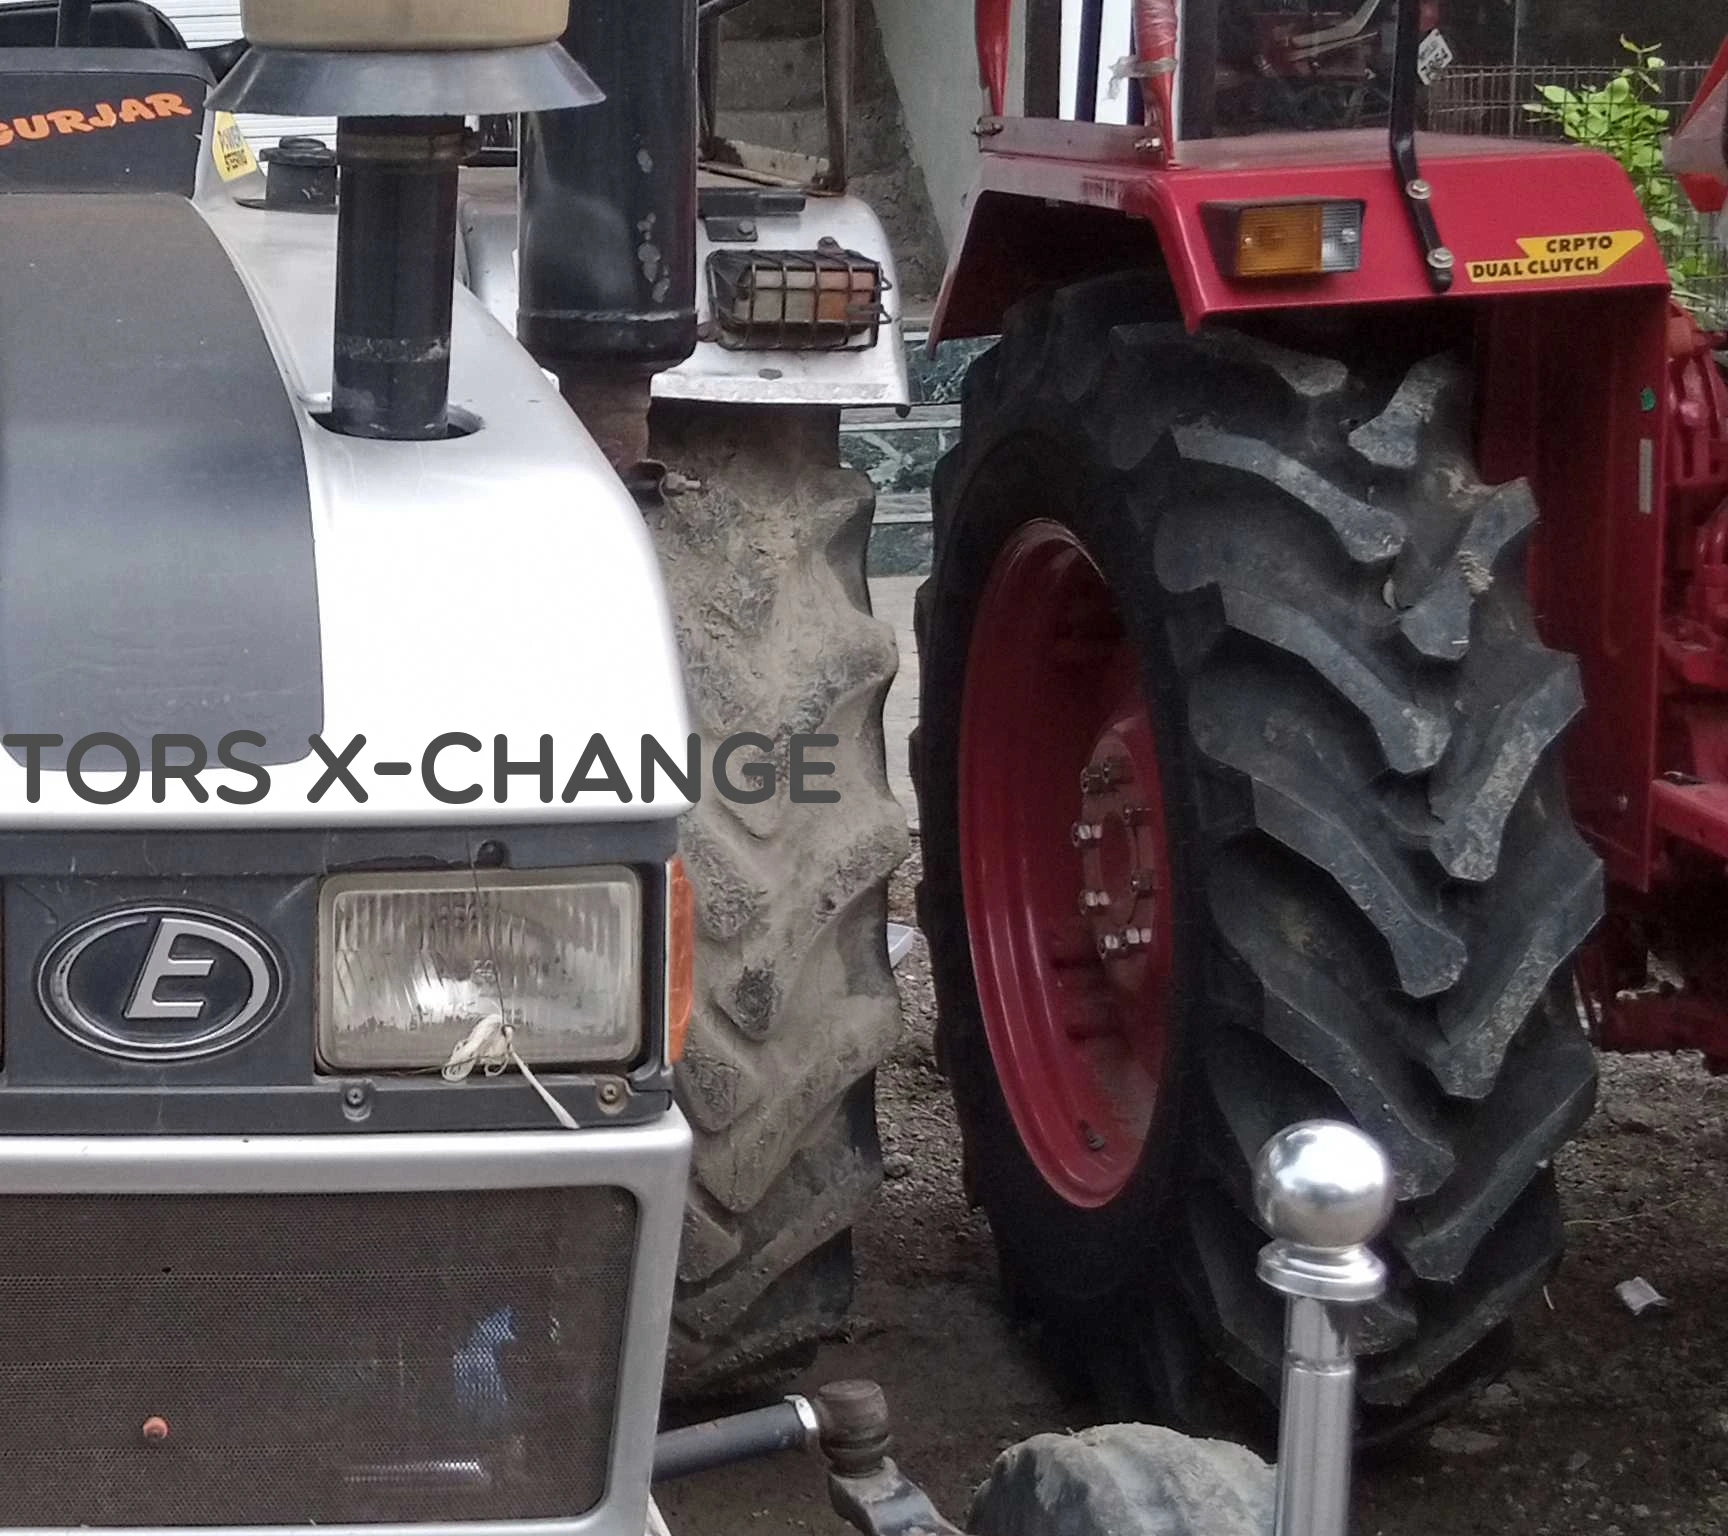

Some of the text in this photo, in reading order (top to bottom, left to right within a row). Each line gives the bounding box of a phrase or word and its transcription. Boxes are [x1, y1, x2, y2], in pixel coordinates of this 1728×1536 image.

[1546, 236, 1613, 253] CRPTO
[1473, 257, 1599, 278] DUAL CLUTCH
